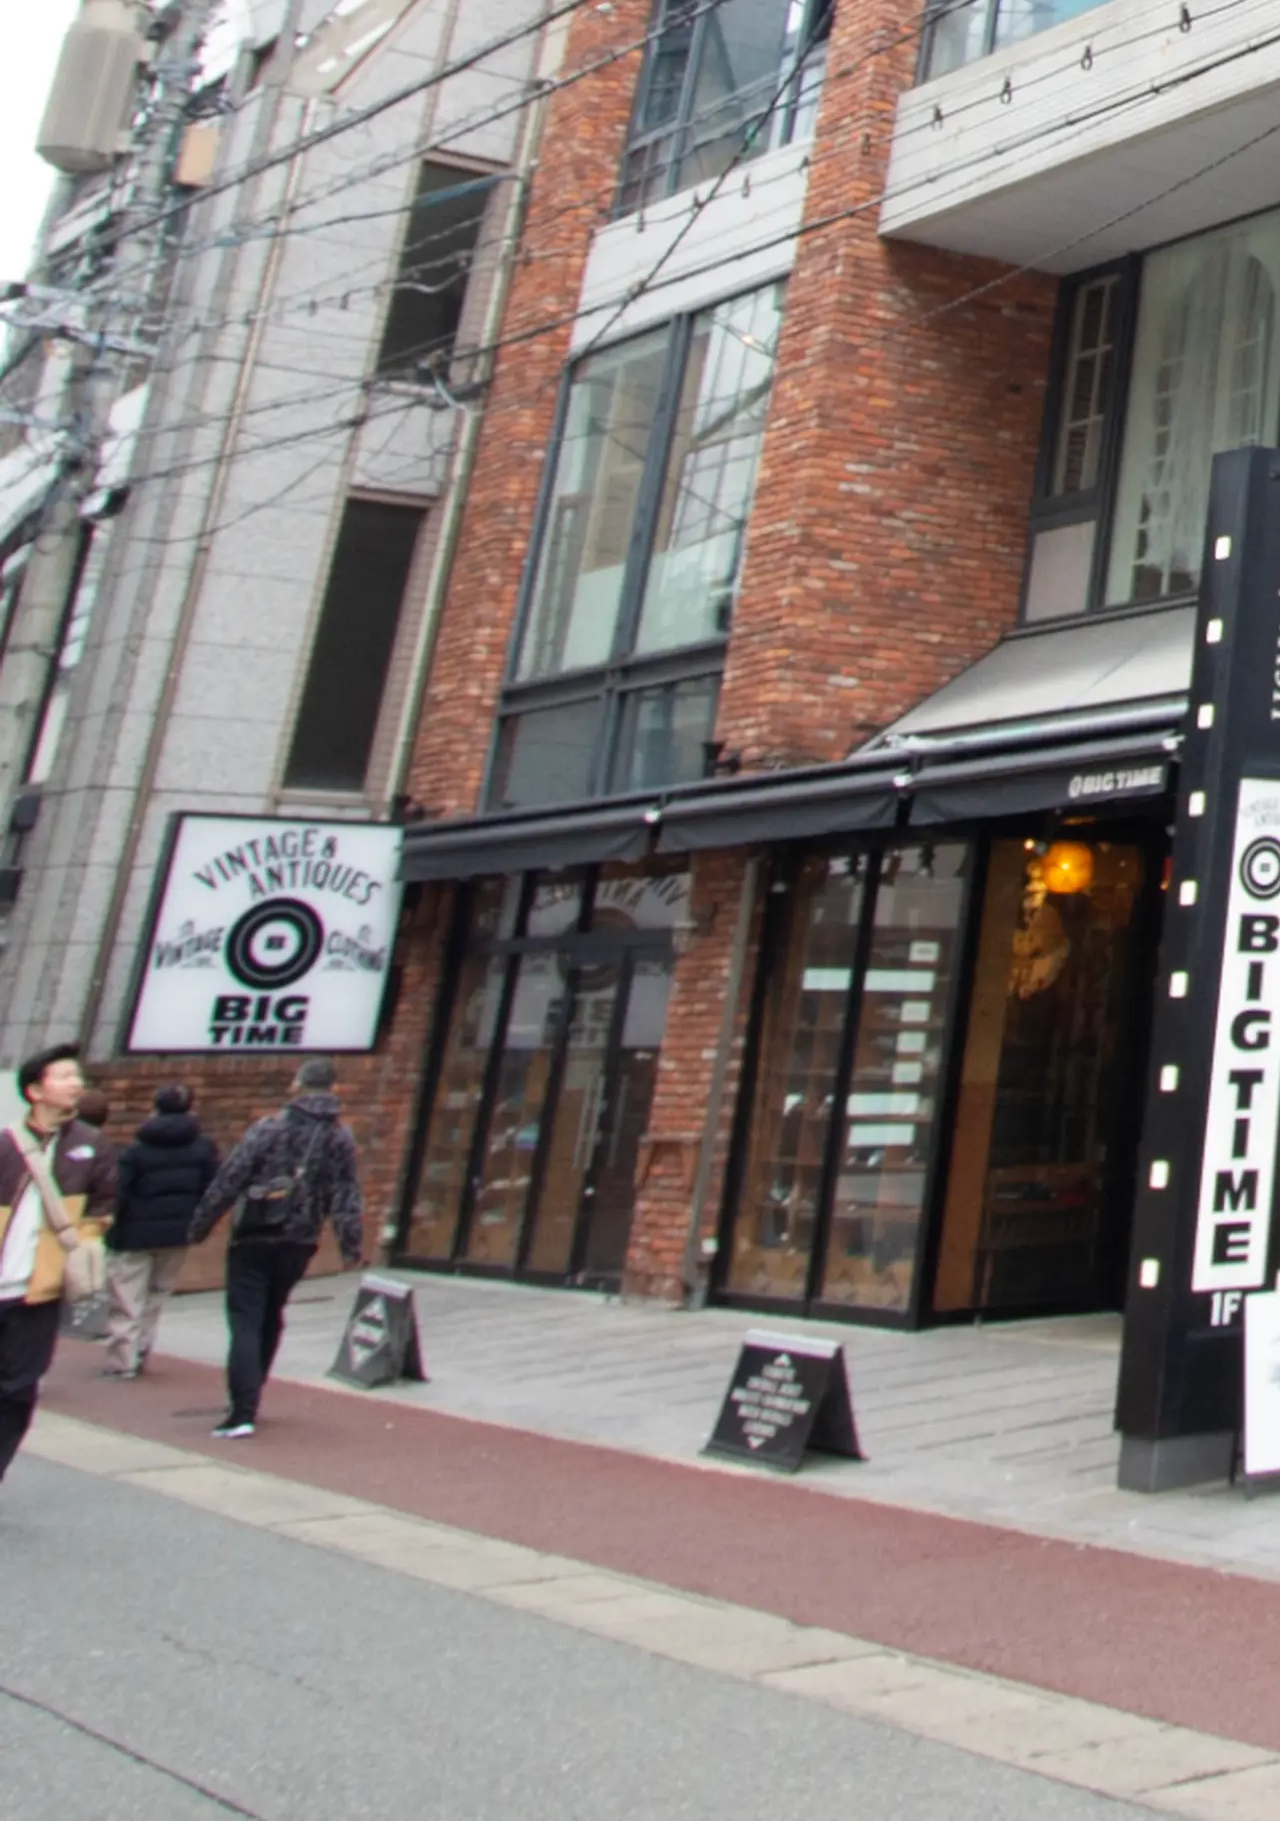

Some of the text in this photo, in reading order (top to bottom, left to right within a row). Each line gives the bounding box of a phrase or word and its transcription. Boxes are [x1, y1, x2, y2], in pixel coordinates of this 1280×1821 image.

[1116, 766, 1162, 789] TIME
[192, 828, 320, 890] VINTAGE
[248, 859, 383, 906] ANTIQUES
[211, 995, 310, 1024] BIG
[208, 1025, 305, 1046] TIME
[1210, 1292, 1242, 1327] 1F
